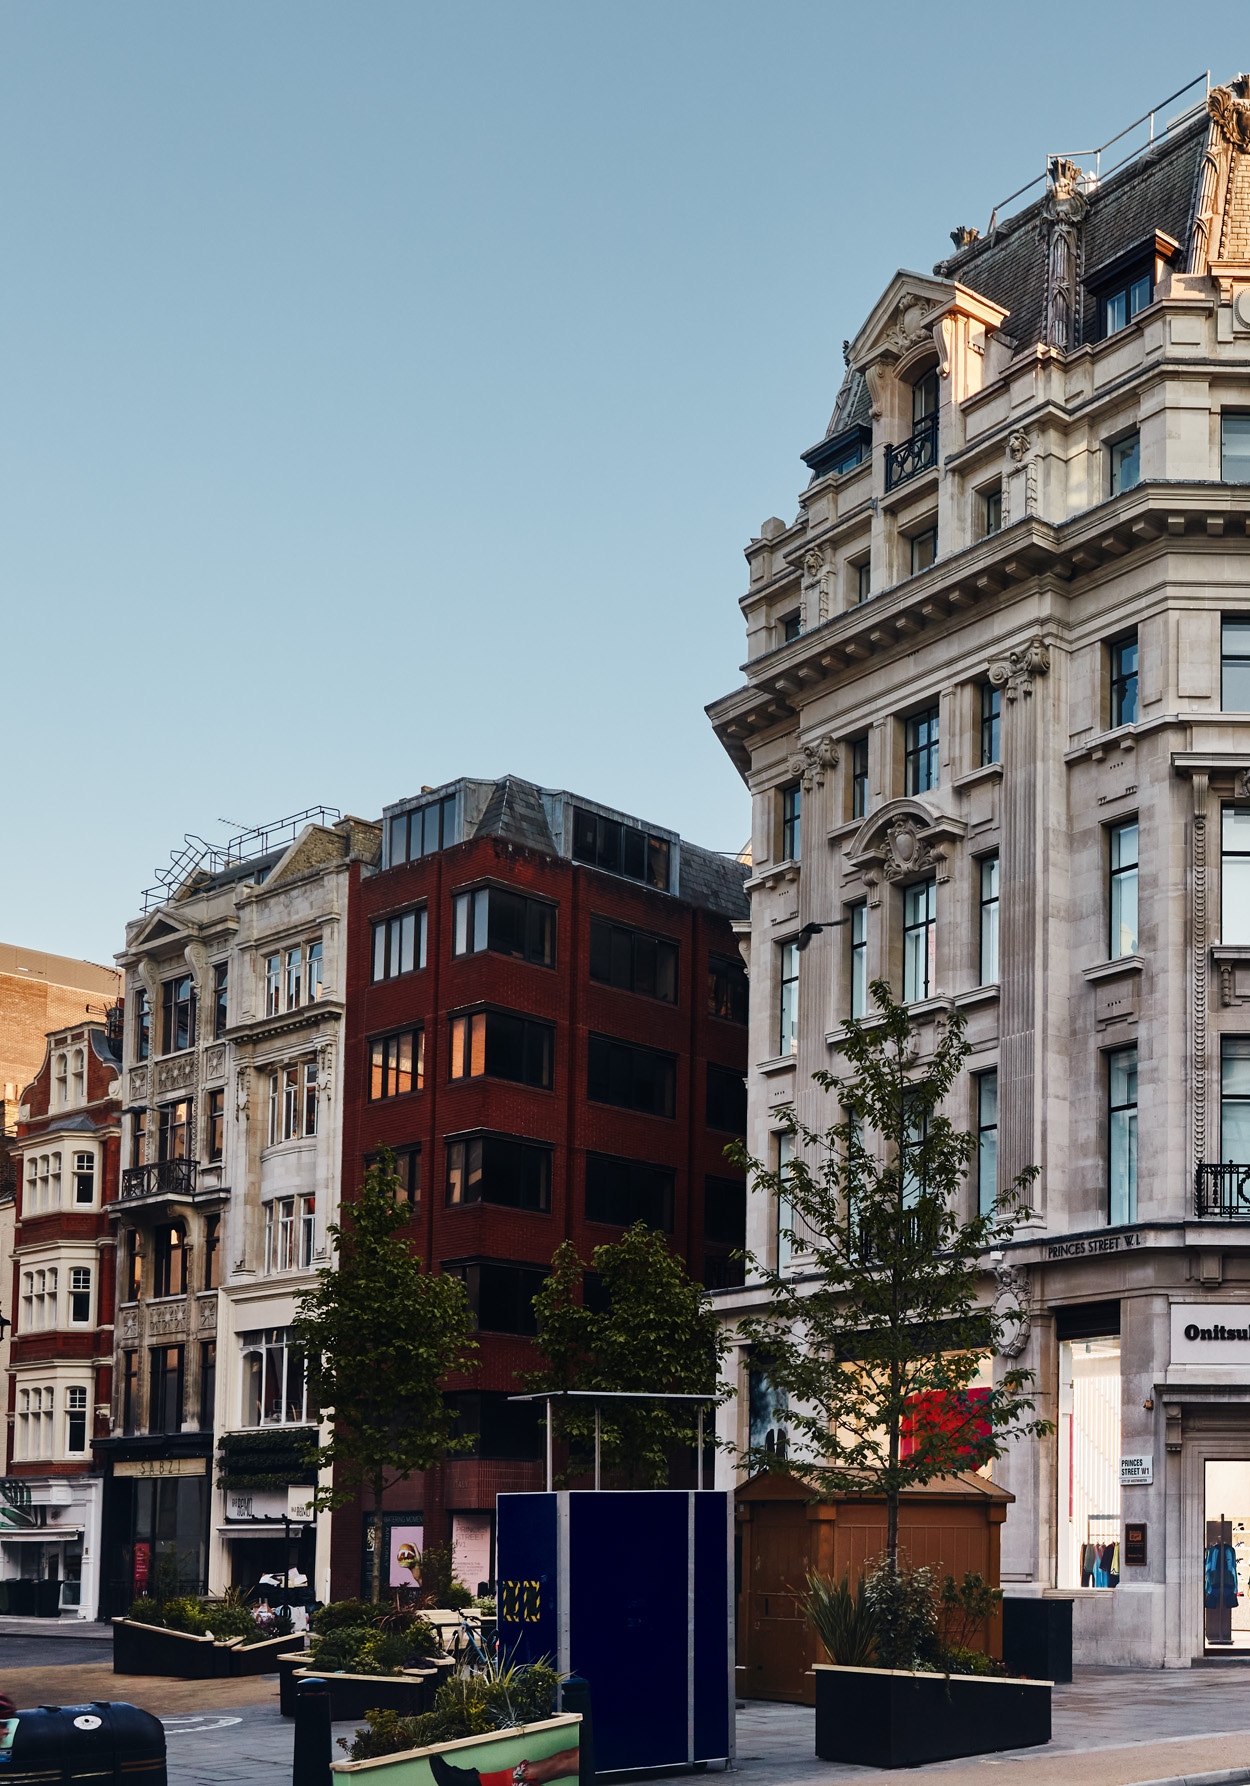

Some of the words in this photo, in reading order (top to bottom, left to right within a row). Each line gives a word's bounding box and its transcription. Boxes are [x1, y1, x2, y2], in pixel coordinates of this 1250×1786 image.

[1048, 1242, 1085, 1258] PRINCES
[1088, 1237, 1120, 1252] STREET
[140, 1459, 181, 1475] SABZI
[1121, 1459, 1143, 1467] PRINCES
[1121, 1467, 1140, 1476] STREET
[1141, 1467, 1149, 1475] W1
